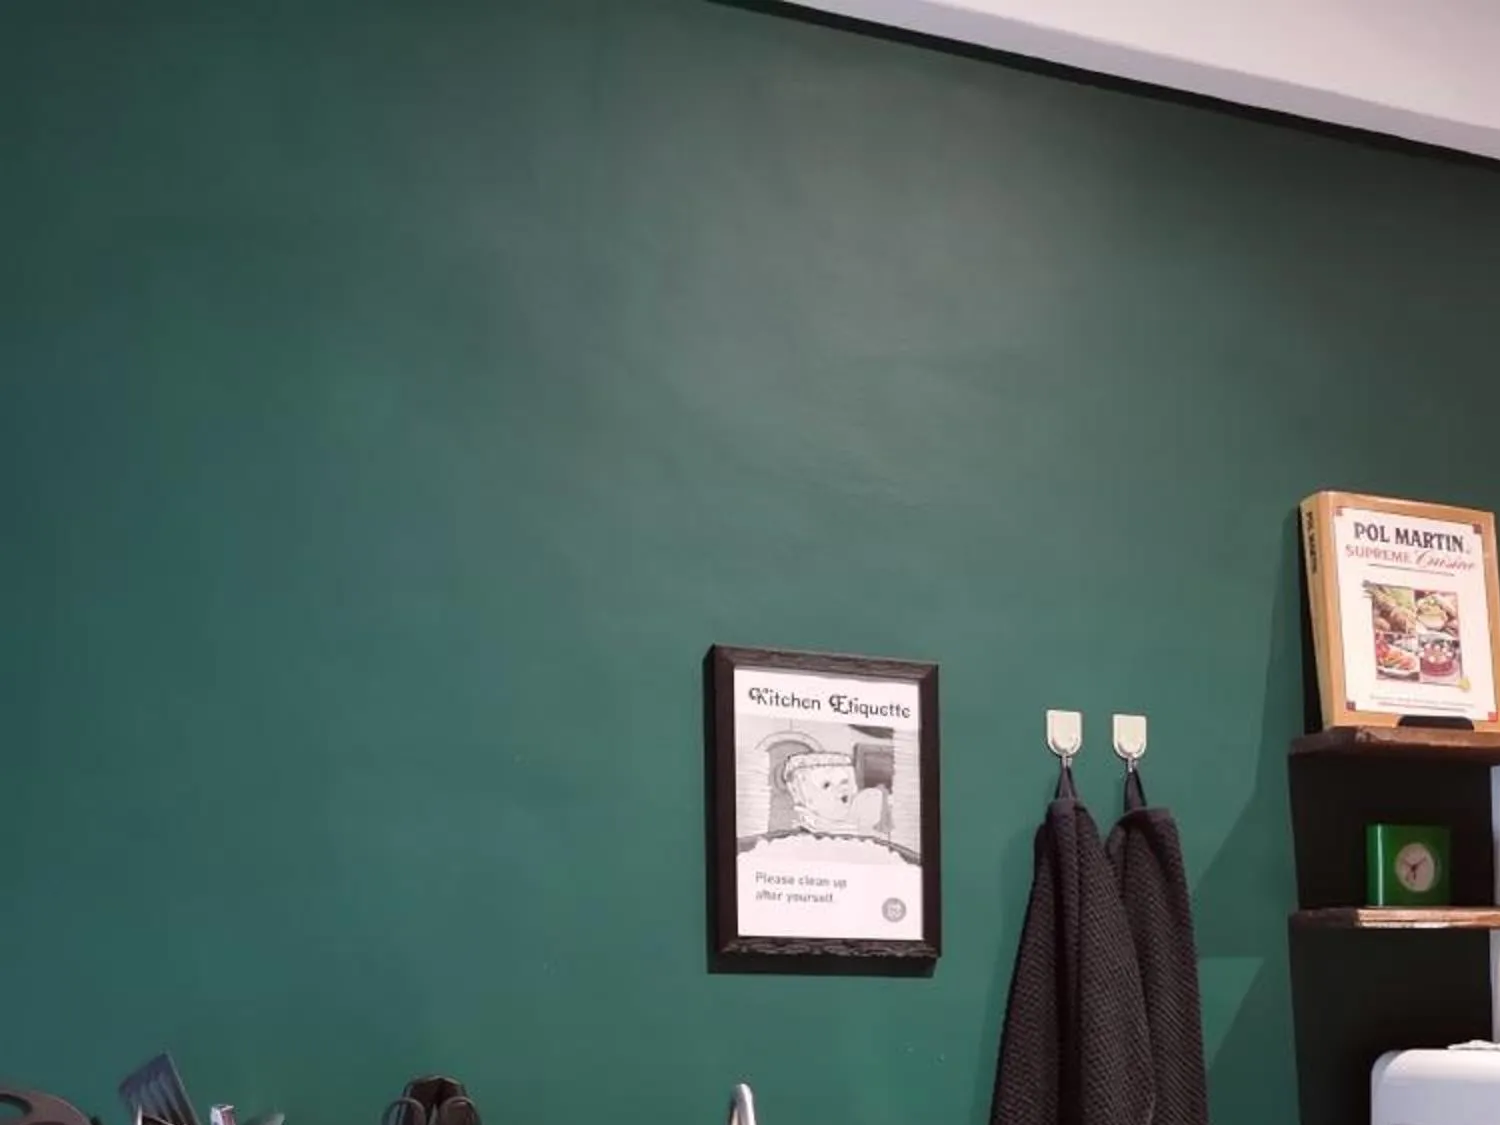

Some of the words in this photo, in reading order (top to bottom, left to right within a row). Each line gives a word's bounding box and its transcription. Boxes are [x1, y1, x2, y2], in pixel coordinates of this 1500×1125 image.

[1353, 522, 1391, 543] POL
[1395, 527, 1464, 554] MARTIN
[1345, 544, 1413, 564] SUPREME
[1414, 550, 1475, 570] Cuisine
[748, 687, 822, 710] Kitchen
[828, 694, 912, 718] Etiquette
[755, 871, 795, 885] Please
[798, 874, 831, 887] clean
[833, 878, 848, 889] up
[755, 889, 783, 901] after
